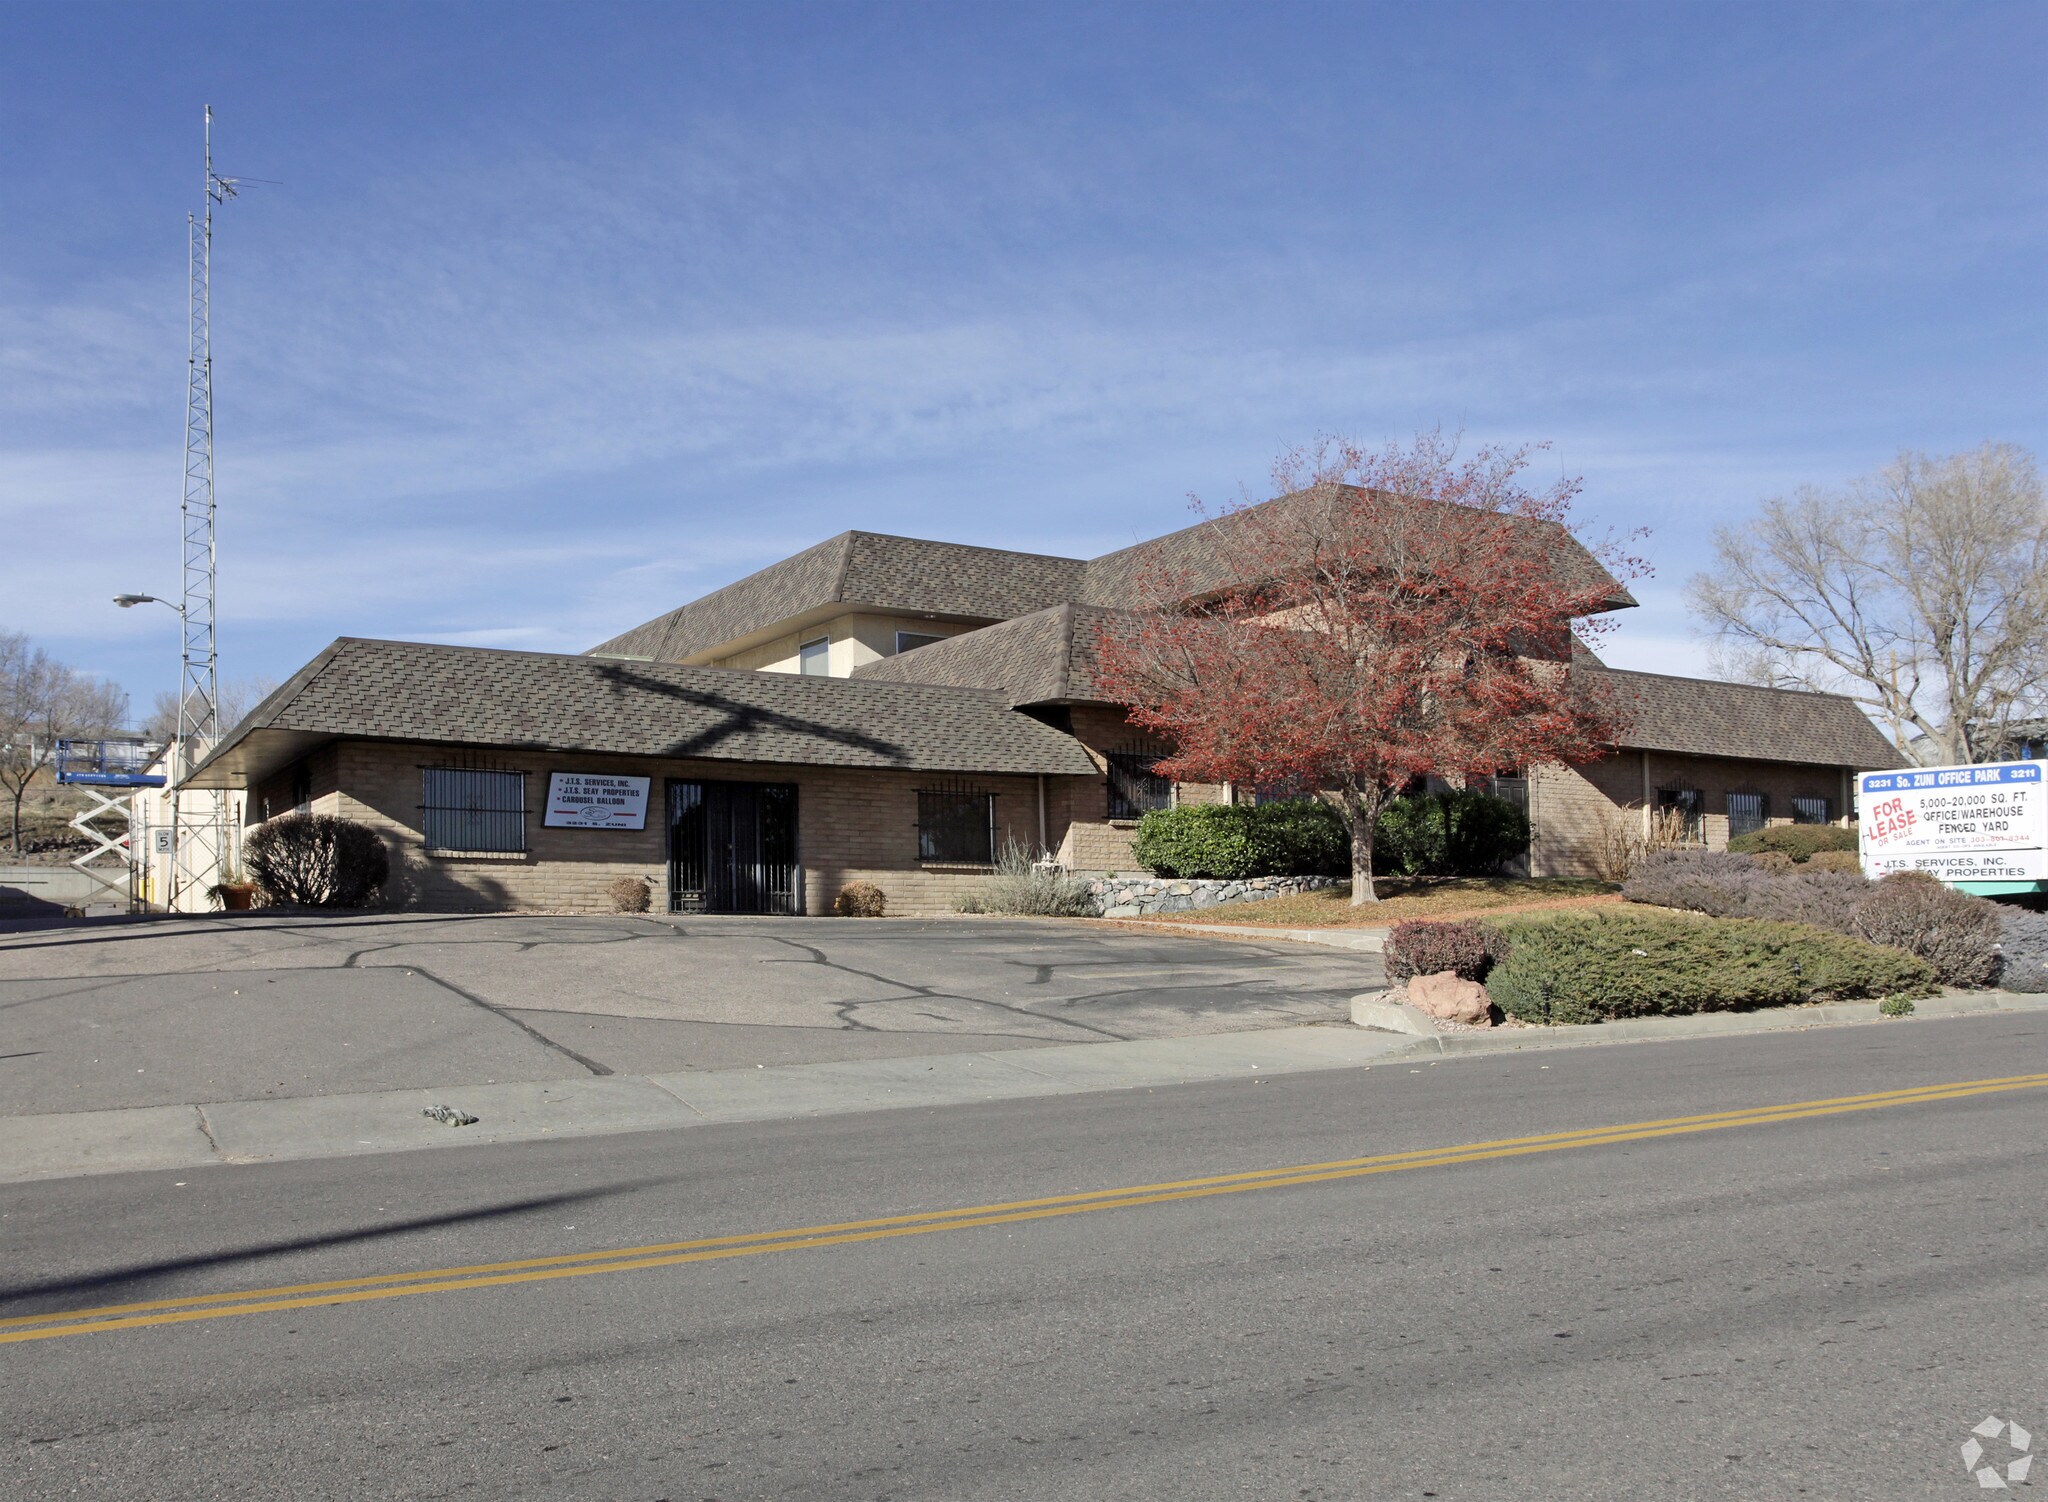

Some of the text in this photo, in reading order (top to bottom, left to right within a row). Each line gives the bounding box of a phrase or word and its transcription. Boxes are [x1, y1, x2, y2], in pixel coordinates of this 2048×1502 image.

[1868, 769, 2035, 788] 3231 So. ZUNI OFFICE PARK 3211
[603, 789, 640, 797] PROPERTIES
[562, 796, 625, 805] CAROUSEL BALLOON
[1920, 792, 2028, 809] 5,000-20,000 SQ. FT.
[1873, 797, 1903, 821] FOR
[1924, 806, 2024, 821] OFFICE/WAREHOUSE
[1868, 809, 1917, 841] LEASE
[1939, 821, 2009, 834] FENCED YARD
[160, 837, 168, 847] 5
[1878, 827, 1913, 847] OR SALE
[1983, 857, 2007, 865] INC.
[1947, 868, 2025, 877] PROPERTIES
